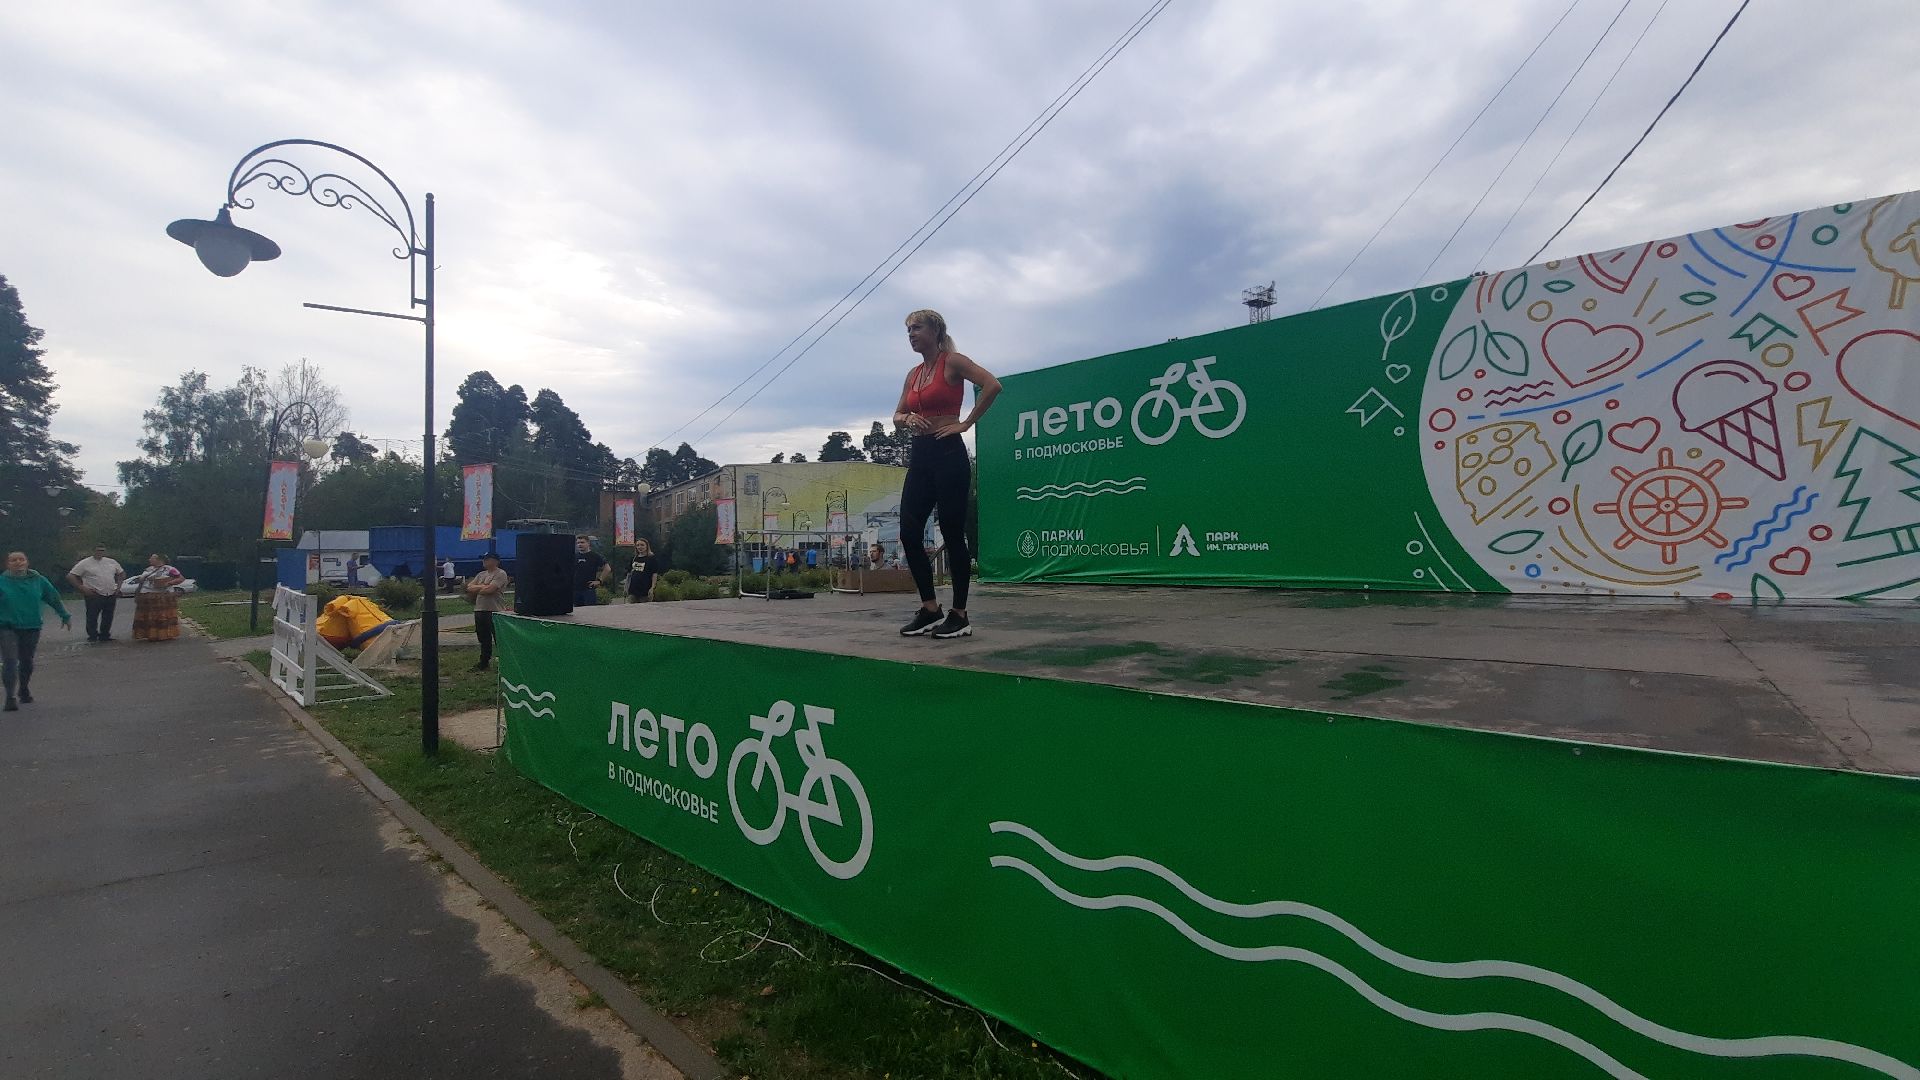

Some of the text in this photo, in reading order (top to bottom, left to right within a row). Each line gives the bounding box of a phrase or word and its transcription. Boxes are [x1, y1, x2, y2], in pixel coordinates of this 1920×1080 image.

[1014, 435, 1124, 461] В ПОДМОСКОВЬЕ
[1041, 529, 1084, 542] ПАРКИ
[1206, 531, 1239, 542] ПАРК
[1041, 542, 1149, 557] ПОДМОСКОВЬЯ
[1222, 542, 1269, 551] ГАГАРИНА
[608, 761, 719, 824] В ПОДМОСКОВЬЕ
